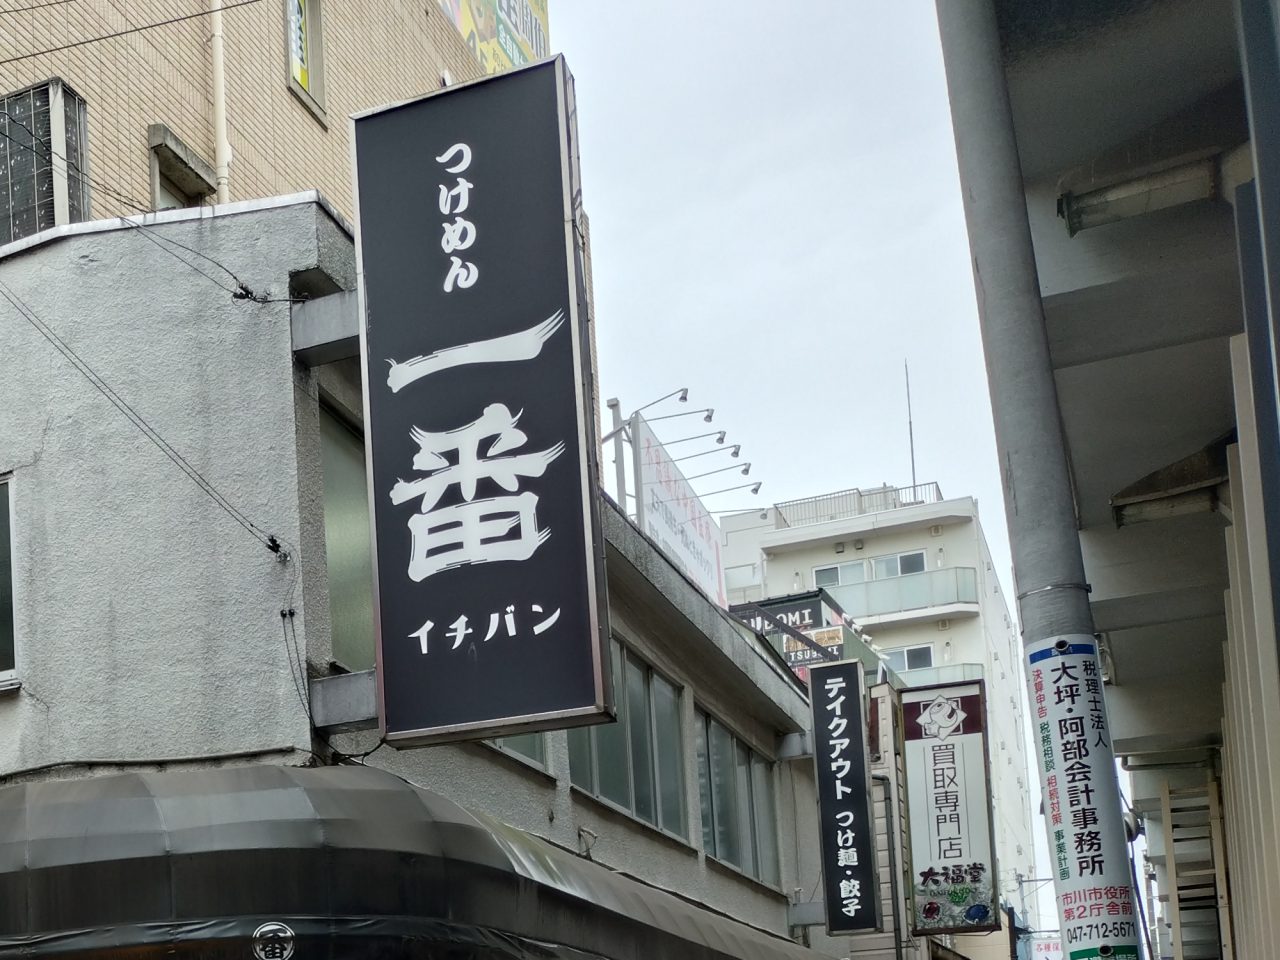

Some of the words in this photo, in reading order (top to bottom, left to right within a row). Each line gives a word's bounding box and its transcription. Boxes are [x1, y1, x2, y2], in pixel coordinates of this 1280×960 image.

[435, 142, 479, 292] つけめん
[384, 309, 565, 582] 一番
[407, 604, 561, 655] イチバン
[824, 677, 852, 800] テイクアウト
[1082, 660, 1107, 748] 税理士法人
[931, 744, 963, 860] 買取専門店
[1051, 662, 1105, 877] 大坪・阿部会計事務所
[835, 811, 862, 917] つけ麺・餃子
[920, 862, 986, 886] 大福堂
[1062, 886, 1131, 906] 市川市役所
[1064, 902, 1133, 922] 第2庁舎前
[1067, 921, 1136, 944] 047-712-5671
